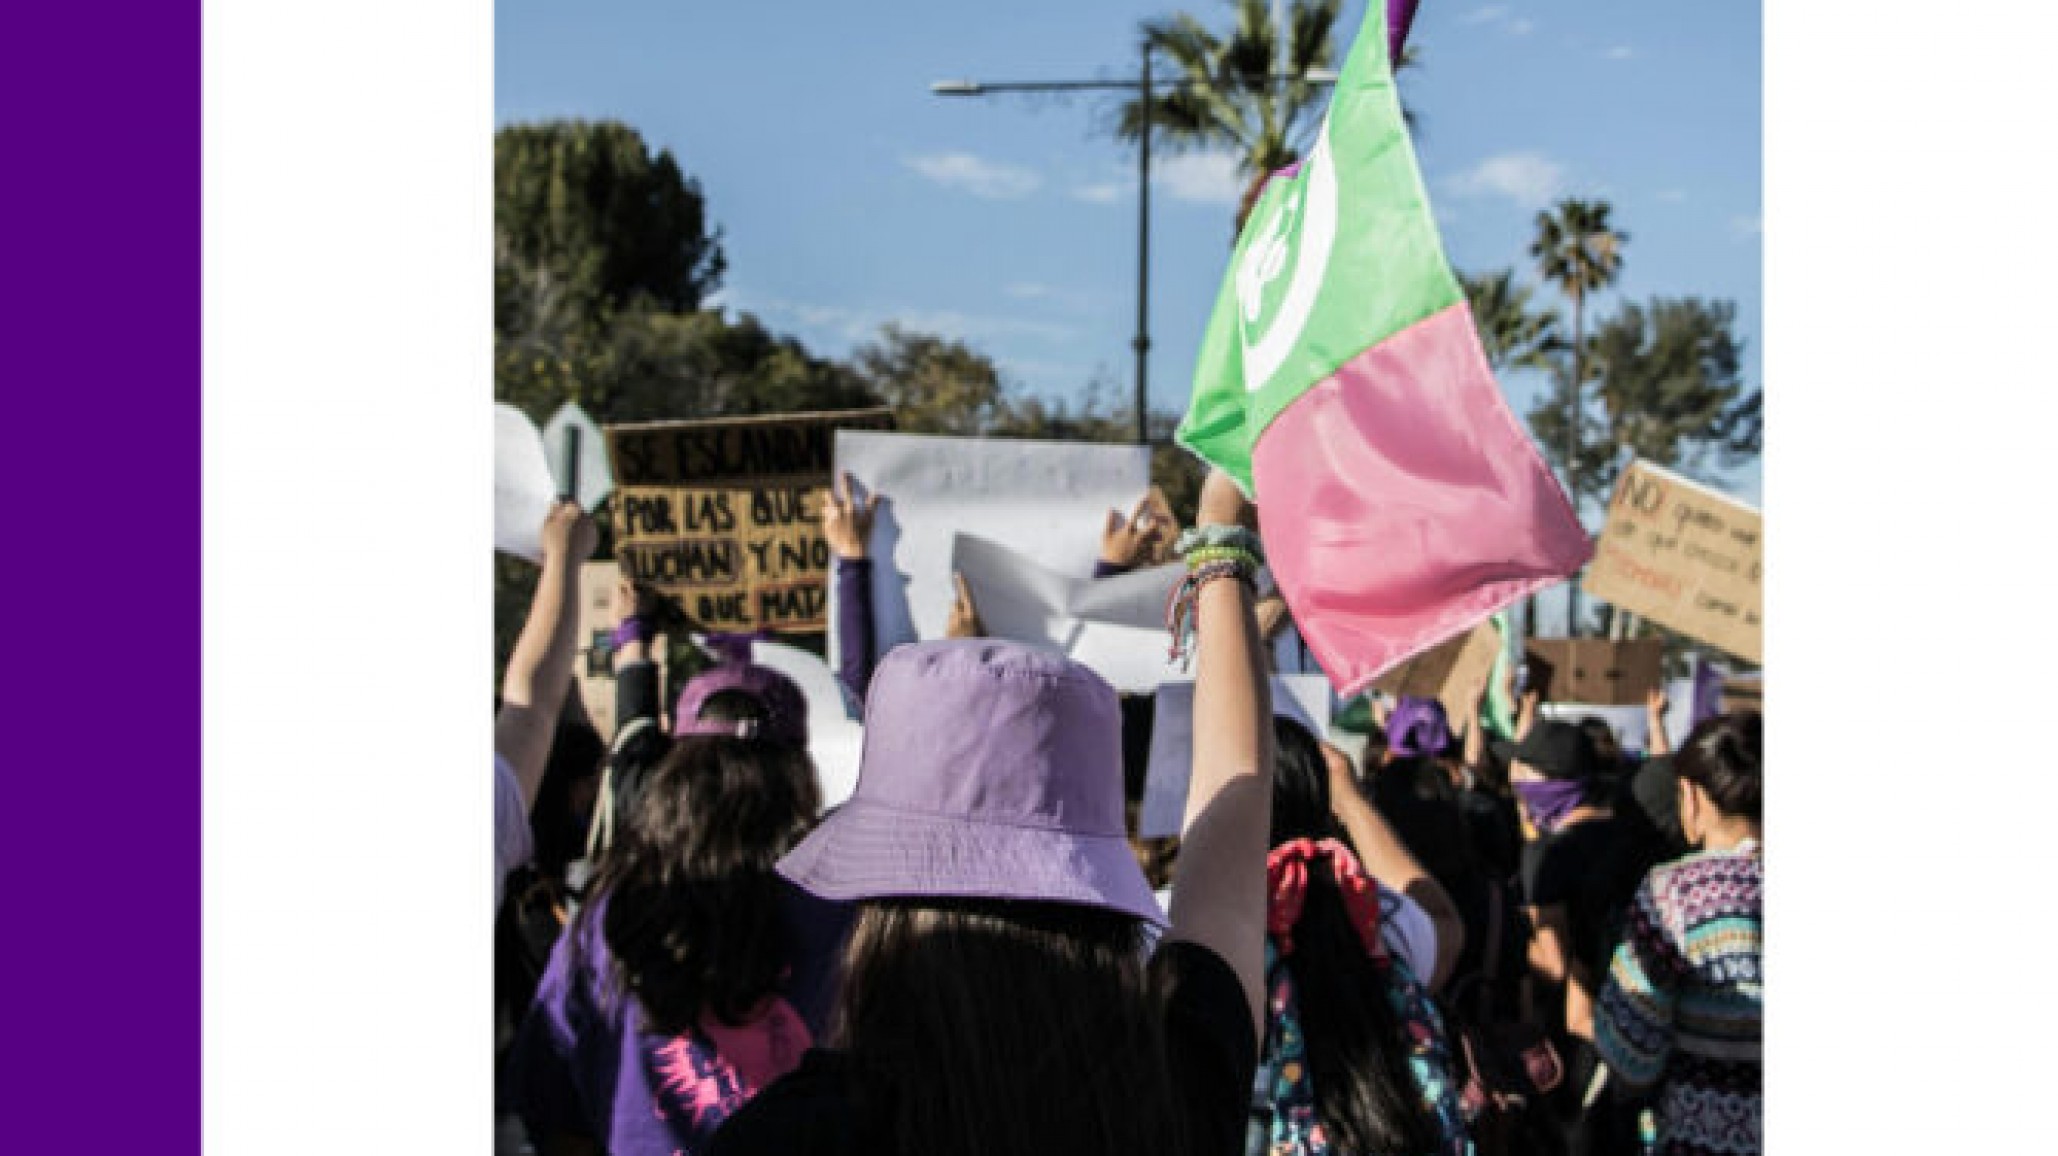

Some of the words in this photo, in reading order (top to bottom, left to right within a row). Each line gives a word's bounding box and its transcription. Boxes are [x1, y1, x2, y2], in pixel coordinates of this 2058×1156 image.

[625, 494, 677, 535] POR
[685, 491, 737, 533] LAS
[752, 487, 822, 525] QUE
[747, 538, 773, 574] Y
[778, 535, 829, 572] NO
[697, 591, 750, 623] QUE
